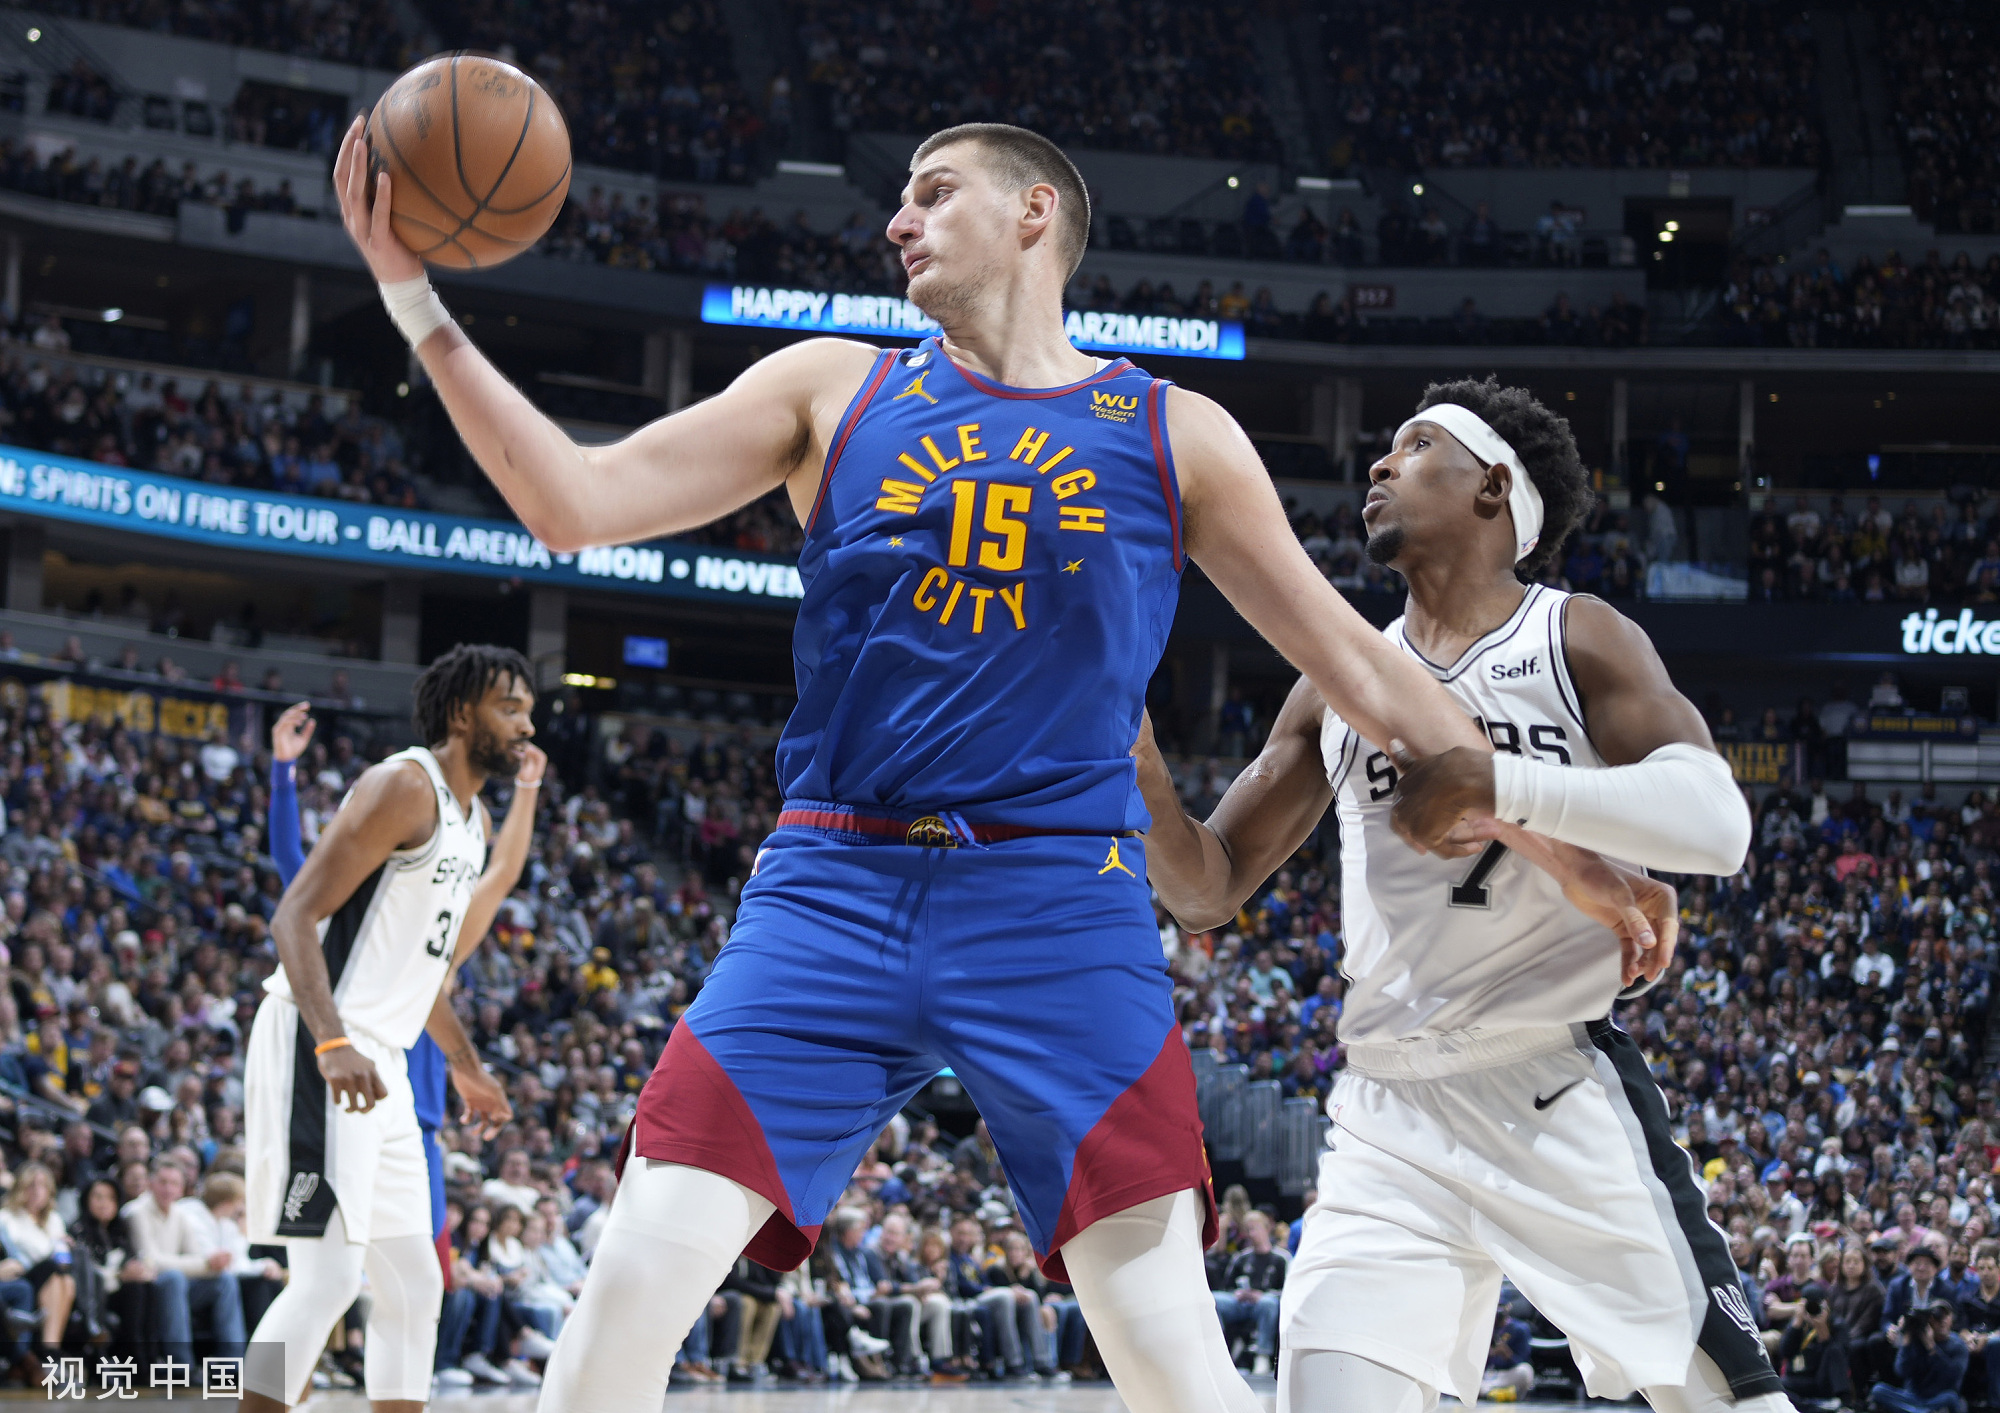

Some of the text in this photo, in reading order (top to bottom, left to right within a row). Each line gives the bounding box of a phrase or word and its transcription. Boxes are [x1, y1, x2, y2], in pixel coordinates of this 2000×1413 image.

[732, 286, 828, 324] HAPPY
[1064, 310, 1219, 352] ARZIMENDI
[1089, 403, 1136, 418] Western
[1092, 390, 1138, 410] WU
[1095, 411, 1127, 423] Union
[875, 423, 1106, 532] MILE HIGH
[30, 463, 131, 515] SPIRITS
[136, 484, 181, 524] ON
[185, 492, 248, 535] FIRE
[253, 502, 338, 545] TOUR
[367, 516, 442, 557] BALL
[444, 526, 551, 570] ARENA
[577, 545, 664, 583] MON
[947, 479, 1034, 572] 15
[912, 565, 1027, 634] CITY
[1490, 656, 1542, 680] Self.
[1365, 715, 1572, 803] SRS
